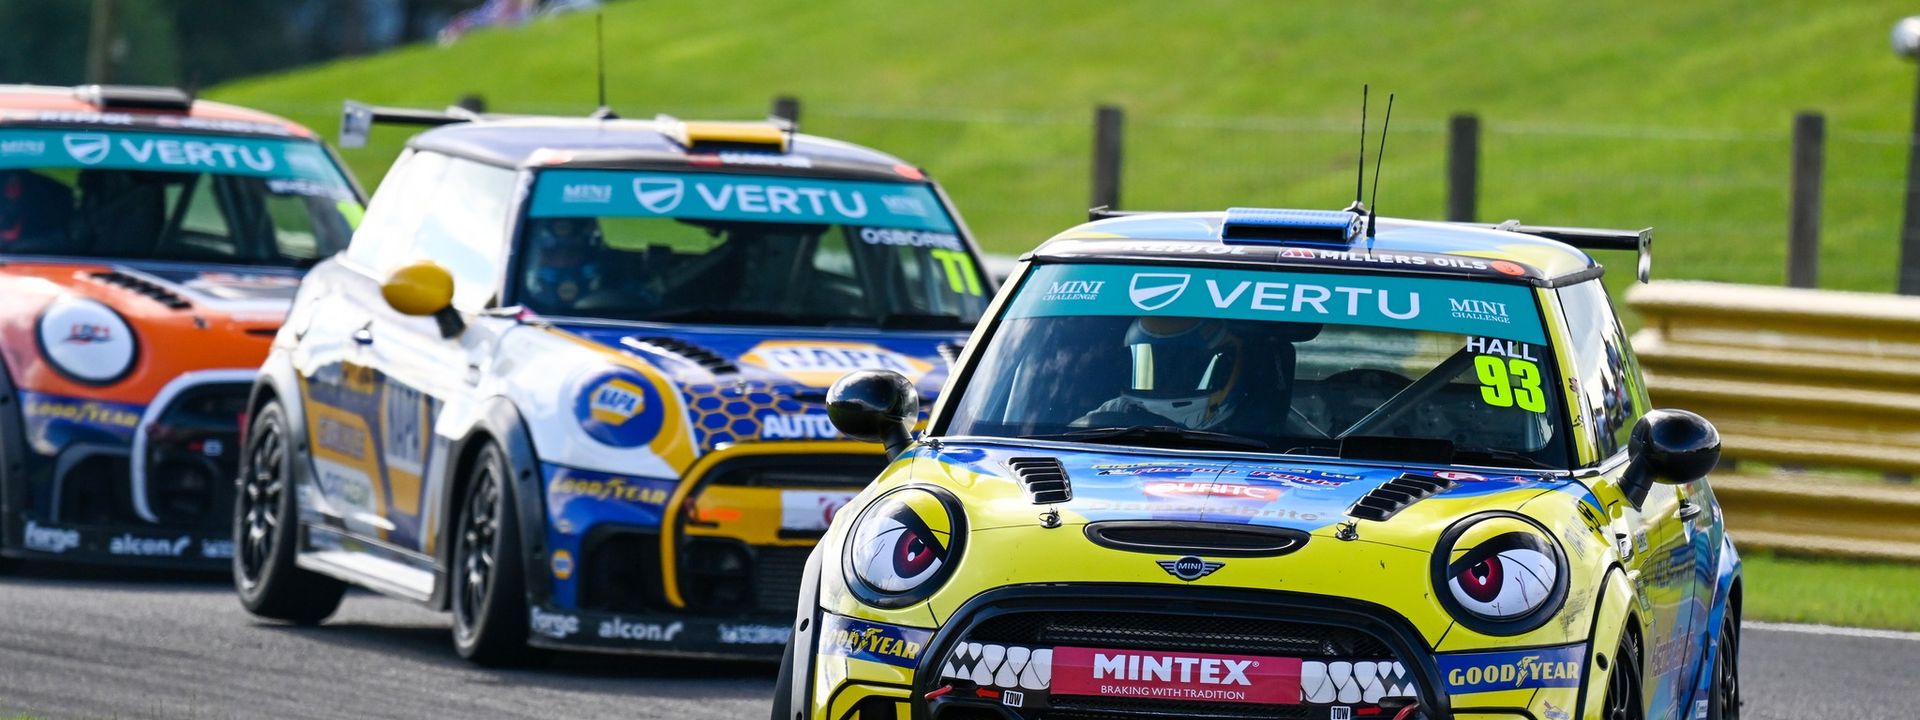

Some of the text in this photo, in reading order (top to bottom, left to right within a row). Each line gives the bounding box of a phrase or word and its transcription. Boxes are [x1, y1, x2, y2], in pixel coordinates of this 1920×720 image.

[120, 137, 275, 172] VERTU
[696, 182, 868, 219] VERTU
[1320, 250, 1488, 271] MILLERS OILS
[1042, 293, 1098, 301] CHALLENGE
[1048, 280, 1105, 296] MINI
[1205, 279, 1420, 320] VERTU
[1449, 298, 1508, 317] MINI
[1452, 311, 1510, 324] CHALLENGE
[1467, 336, 1538, 362] HALL
[770, 349, 912, 371] NAPA
[1474, 355, 1546, 413] 93
[600, 387, 637, 413] NAPA
[110, 533, 172, 555] alcon
[1178, 562, 1201, 570] MINI
[599, 617, 662, 640] alcon
[1005, 691, 1022, 705] TOW
[1101, 685, 1245, 700] BRAKING WITH TRADITION
[1332, 707, 1349, 720] TOW
